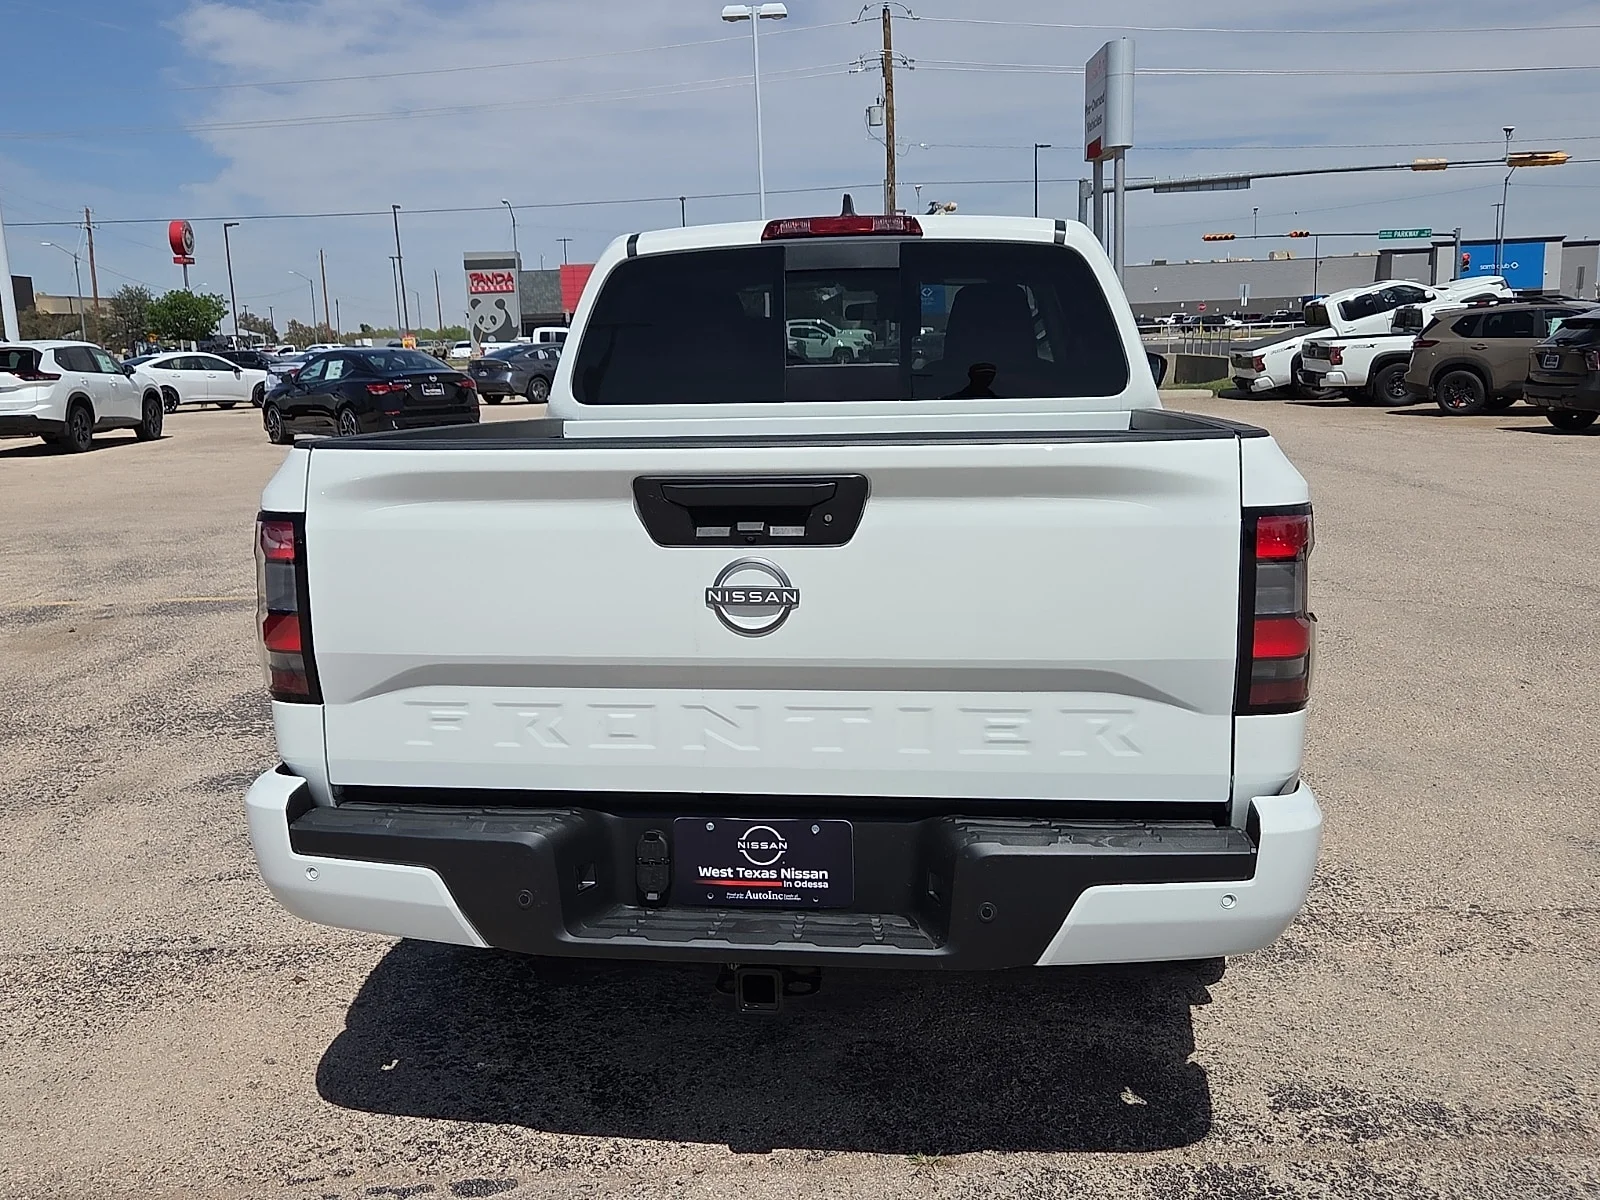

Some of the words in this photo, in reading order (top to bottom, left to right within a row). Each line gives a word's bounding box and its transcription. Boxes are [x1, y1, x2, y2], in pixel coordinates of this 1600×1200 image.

[1393, 230, 1420, 238] PARKWAY
[469, 271, 514, 287] PANDA
[708, 590, 797, 603] NISSAN
[403, 700, 1143, 757] FRONTIER
[737, 841, 788, 850] NISSAN
[698, 866, 734, 878] West
[736, 867, 778, 879] Texas
[781, 868, 829, 880] Nissan
[783, 880, 793, 888] In
[794, 880, 829, 889] Odessa
[745, 889, 784, 901] AutoInc
